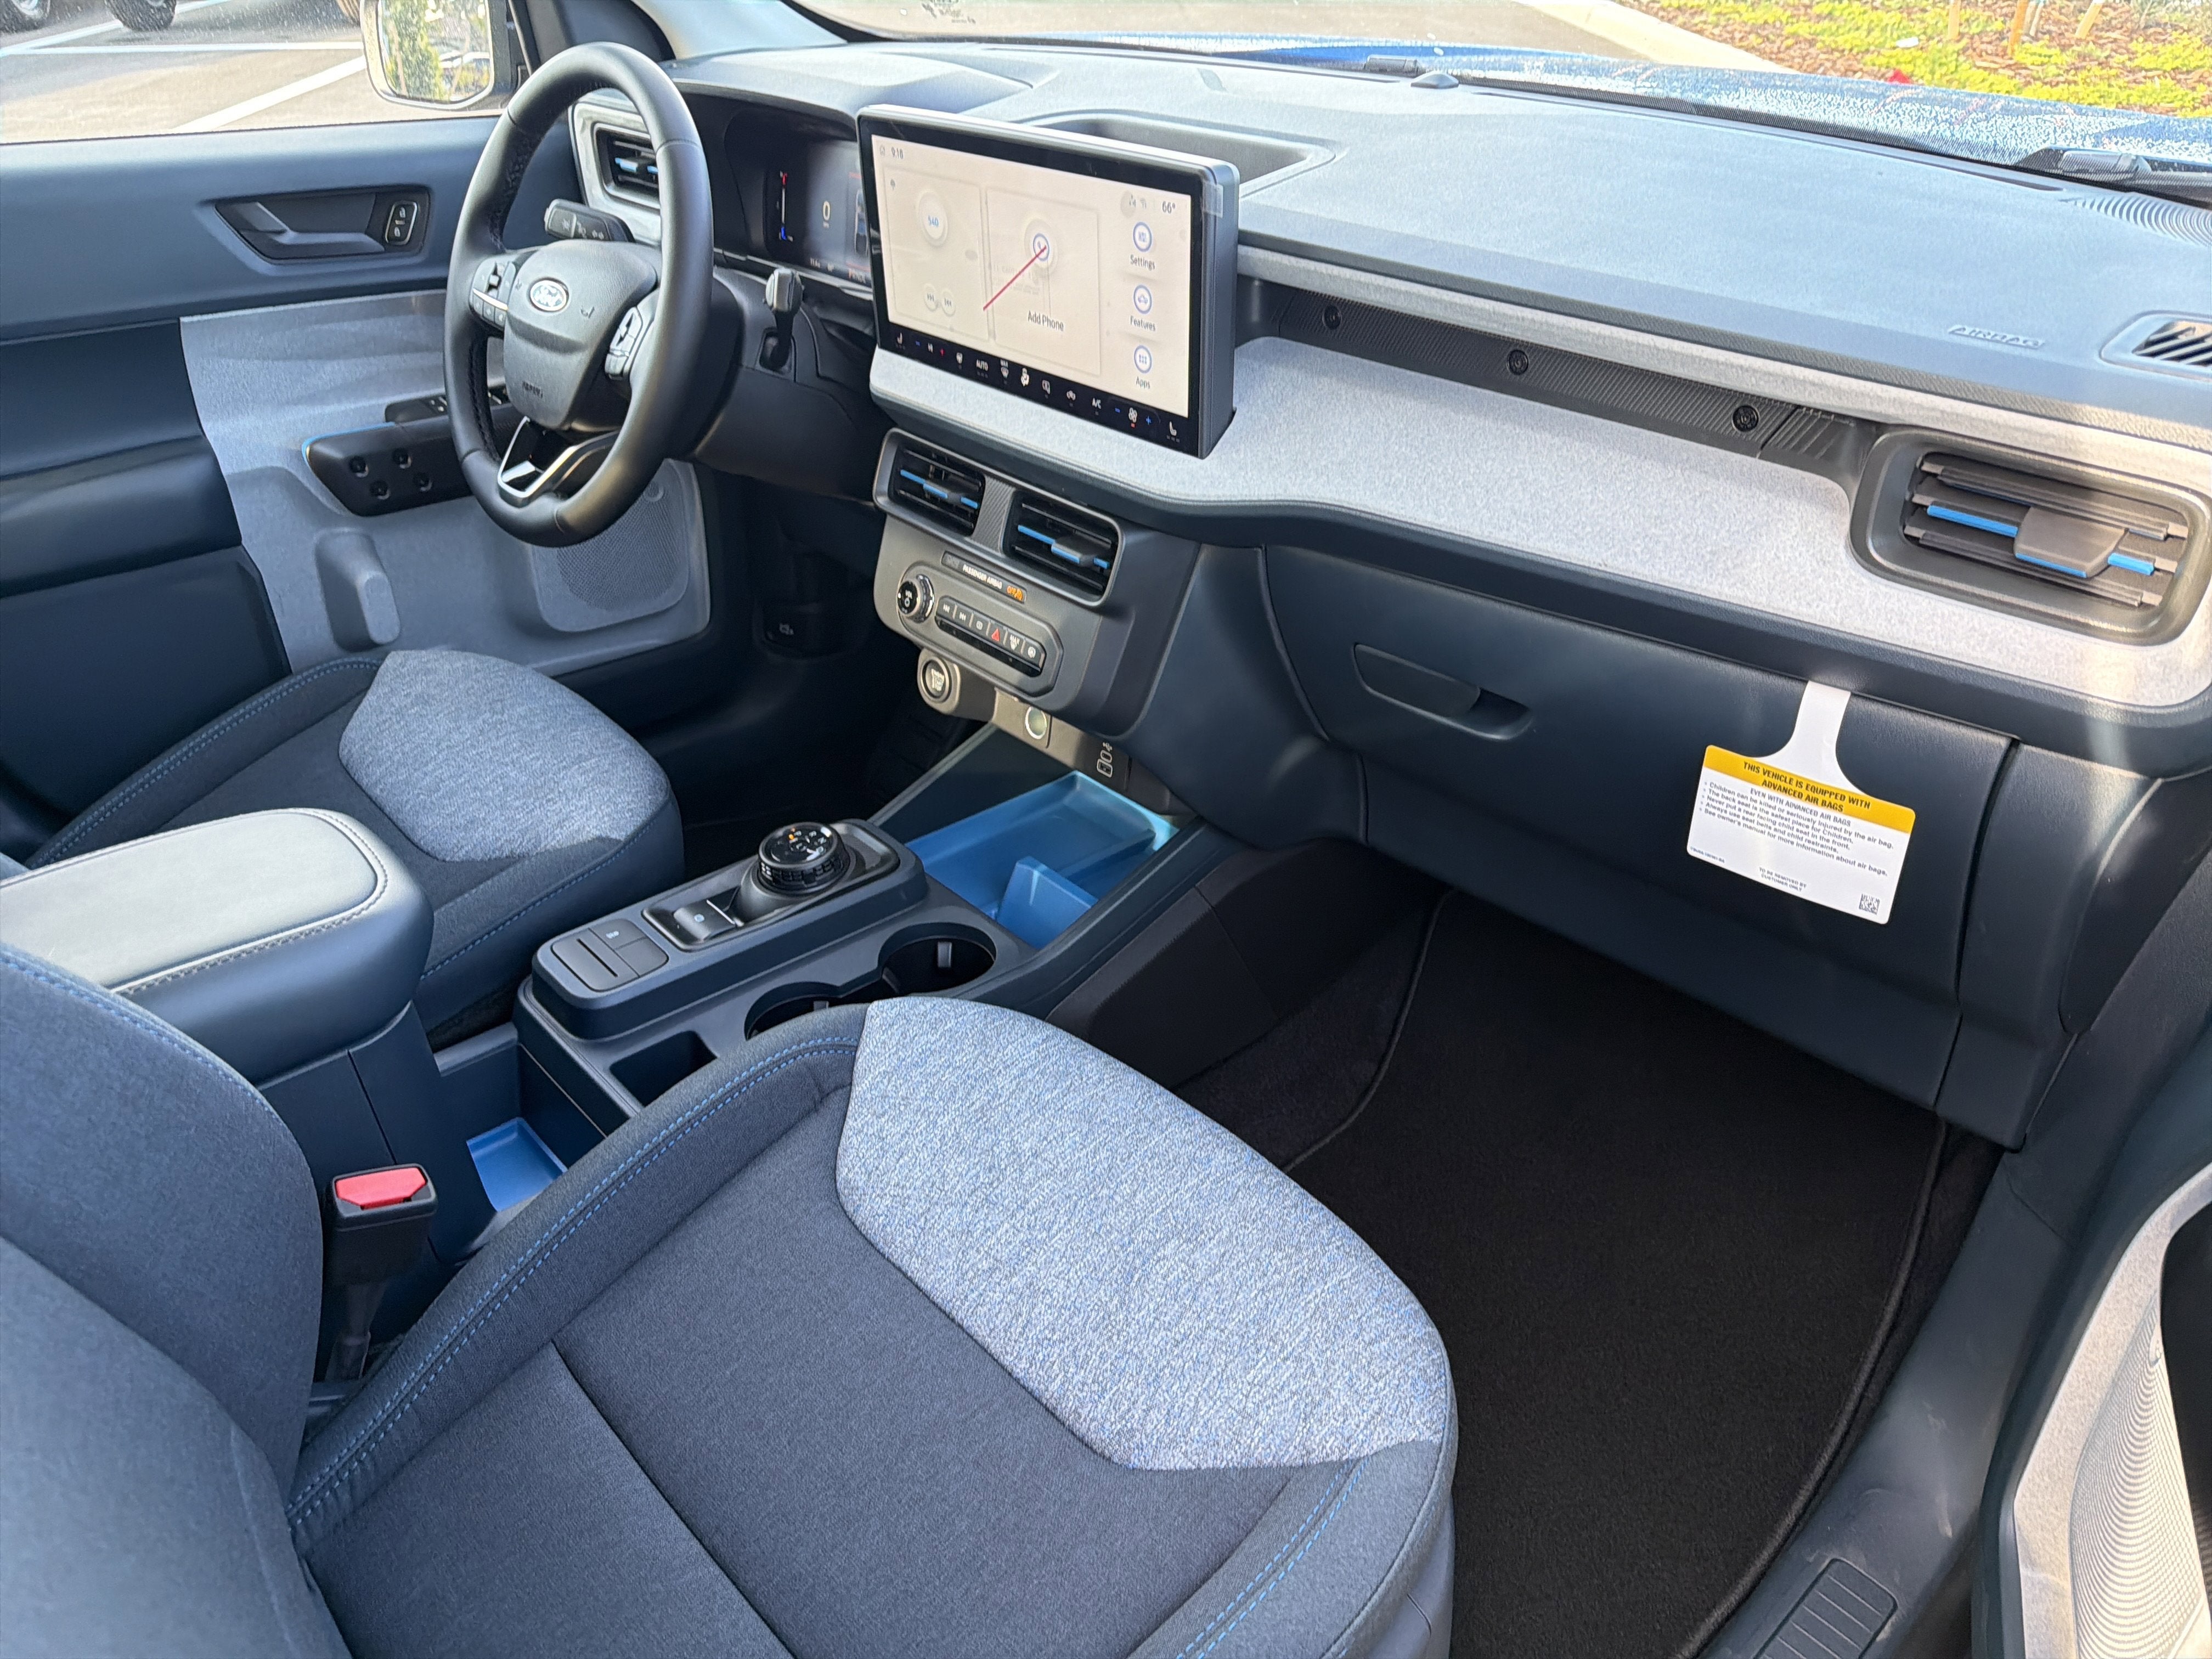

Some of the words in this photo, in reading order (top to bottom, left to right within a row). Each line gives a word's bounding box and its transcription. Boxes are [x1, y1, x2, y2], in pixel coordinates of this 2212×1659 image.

[1130, 255, 1155, 270] Settings
[1028, 310, 1041, 325] Add
[1042, 315, 1064, 331] Phone
[1130, 315, 1156, 331] Features
[976, 359, 989, 371] AUTO
[1136, 376, 1150, 390] Apps
[1092, 398, 1102, 409] A/C
[1743, 761, 1760, 774] THIS
[1762, 768, 1794, 786] VEHICLE
[1796, 779, 1803, 789] IS
[1805, 783, 1846, 802] EQUIPPED
[1848, 796, 1871, 809] WITH
[1762, 780, 1803, 799] ADVANCED
[1805, 794, 1819, 805] AIR
[1821, 799, 1843, 812] BAGS
[1707, 795, 1725, 805] Never
[1726, 803, 1736, 811] put
[1743, 809, 1756, 817] rear
[1757, 813, 1776, 826] facing
[1778, 821, 1795, 832] child
[1796, 827, 1809, 837] seat
[1819, 834, 1830, 843] the
[1832, 839, 1850, 850] front.
[1708, 788, 1720, 797] The
[1721, 793, 1736, 803] back
[1737, 800, 1751, 809] seat
[1771, 811, 1790, 823] safest
[1792, 818, 1809, 830] place
[1812, 823, 1820, 832] for
[1822, 828, 1853, 844] Children.
[1709, 782, 1735, 795] Children
[1759, 799, 1776, 811] killed
[1786, 810, 1817, 826] seriously
[1818, 820, 1842, 833] injured
[1844, 828, 1853, 837] by
[1867, 835, 1877, 843] air
[1878, 839, 1893, 849] bag.
[1751, 787, 1766, 798] EVEN
[1768, 793, 1784, 805] WITH
[1785, 800, 1818, 817] ADVANCED
[1820, 812, 1831, 821] AIR
[1833, 816, 1851, 827] BAGS
[1704, 808, 1716, 816] See
[1717, 814, 1741, 826] owner's
[1742, 823, 1765, 836] manual
[1768, 831, 1776, 839] for
[1778, 836, 1795, 845] more
[1796, 841, 1835, 859] information
[1836, 856, 1856, 866] about
[1869, 865, 1887, 877] bags.
[1706, 802, 1728, 814] Always
[1729, 811, 1740, 819] use
[1742, 816, 1755, 824] seat
[1757, 820, 1771, 831] belts
[1773, 827, 1786, 836] and
[1787, 832, 1804, 842] child
[1804, 838, 1838, 854] restraints.
[1774, 872, 1798, 885] REMOVED
